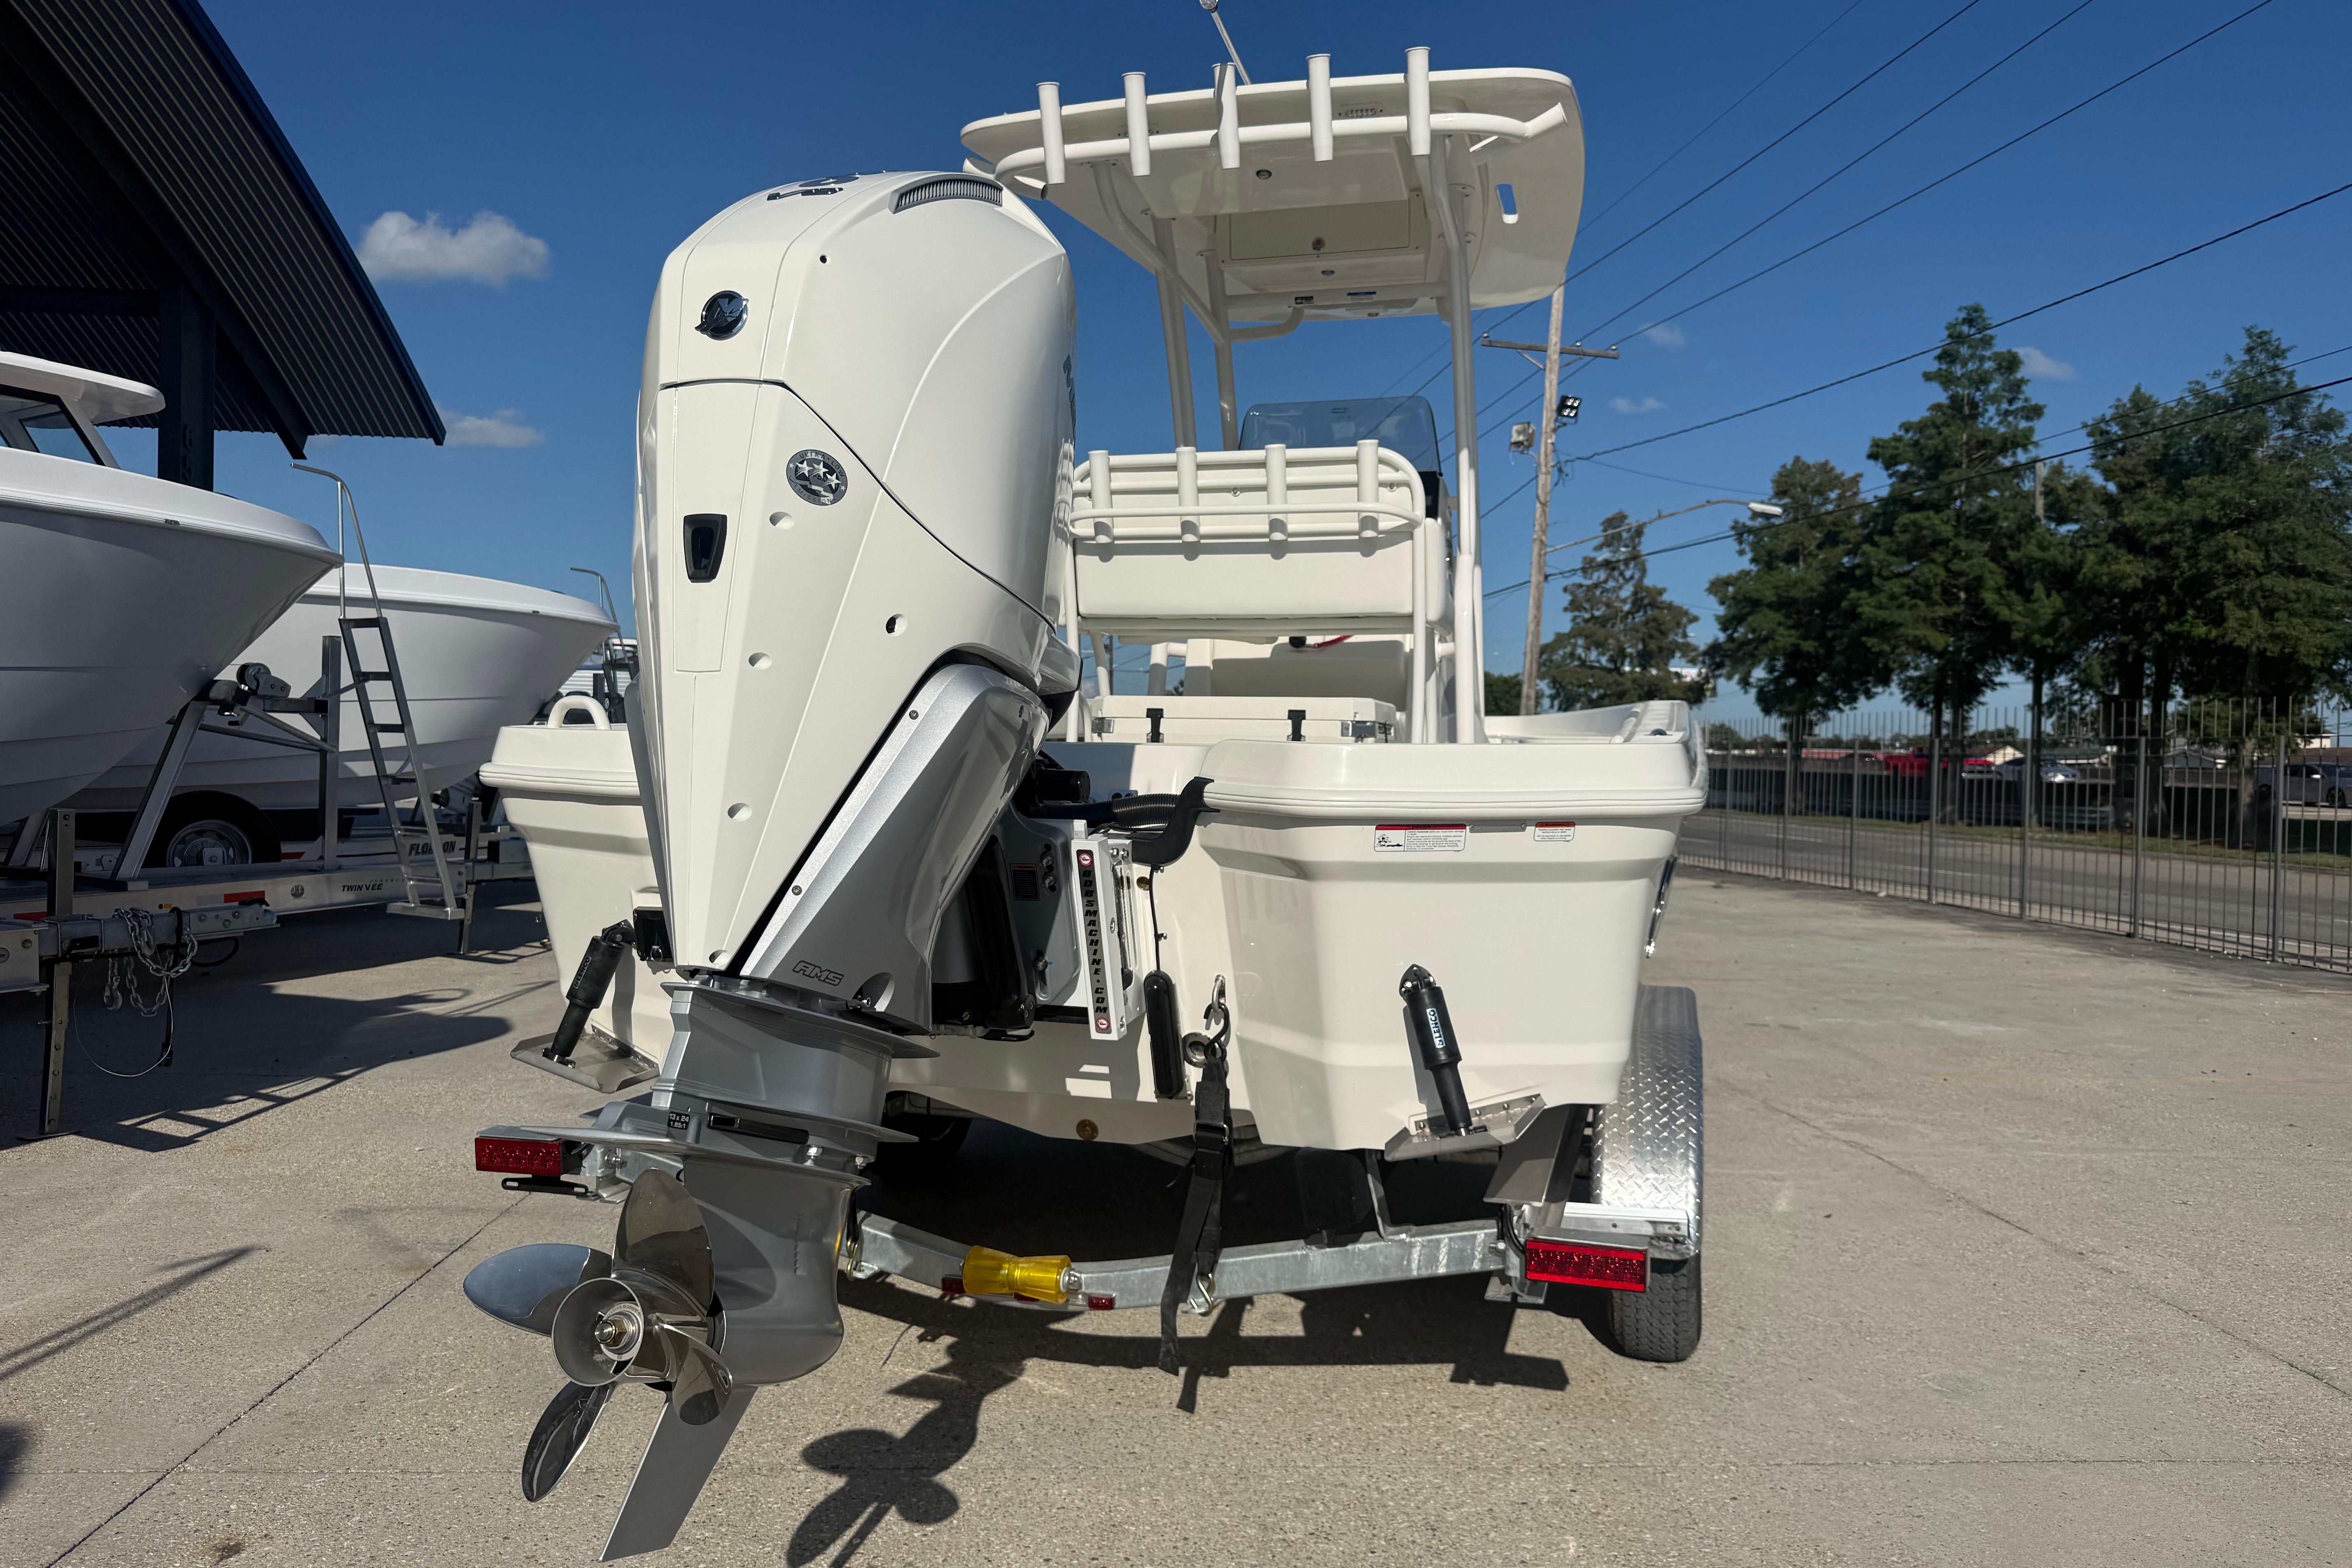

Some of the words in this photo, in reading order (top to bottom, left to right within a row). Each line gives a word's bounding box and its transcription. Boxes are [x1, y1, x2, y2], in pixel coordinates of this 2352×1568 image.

[799, 451, 824, 460] ULTRA
[831, 460, 845, 477] LOW
[576, 957, 590, 981] LENCO
[792, 960, 845, 986] AMS
[1429, 1010, 1442, 1038] LENCO
